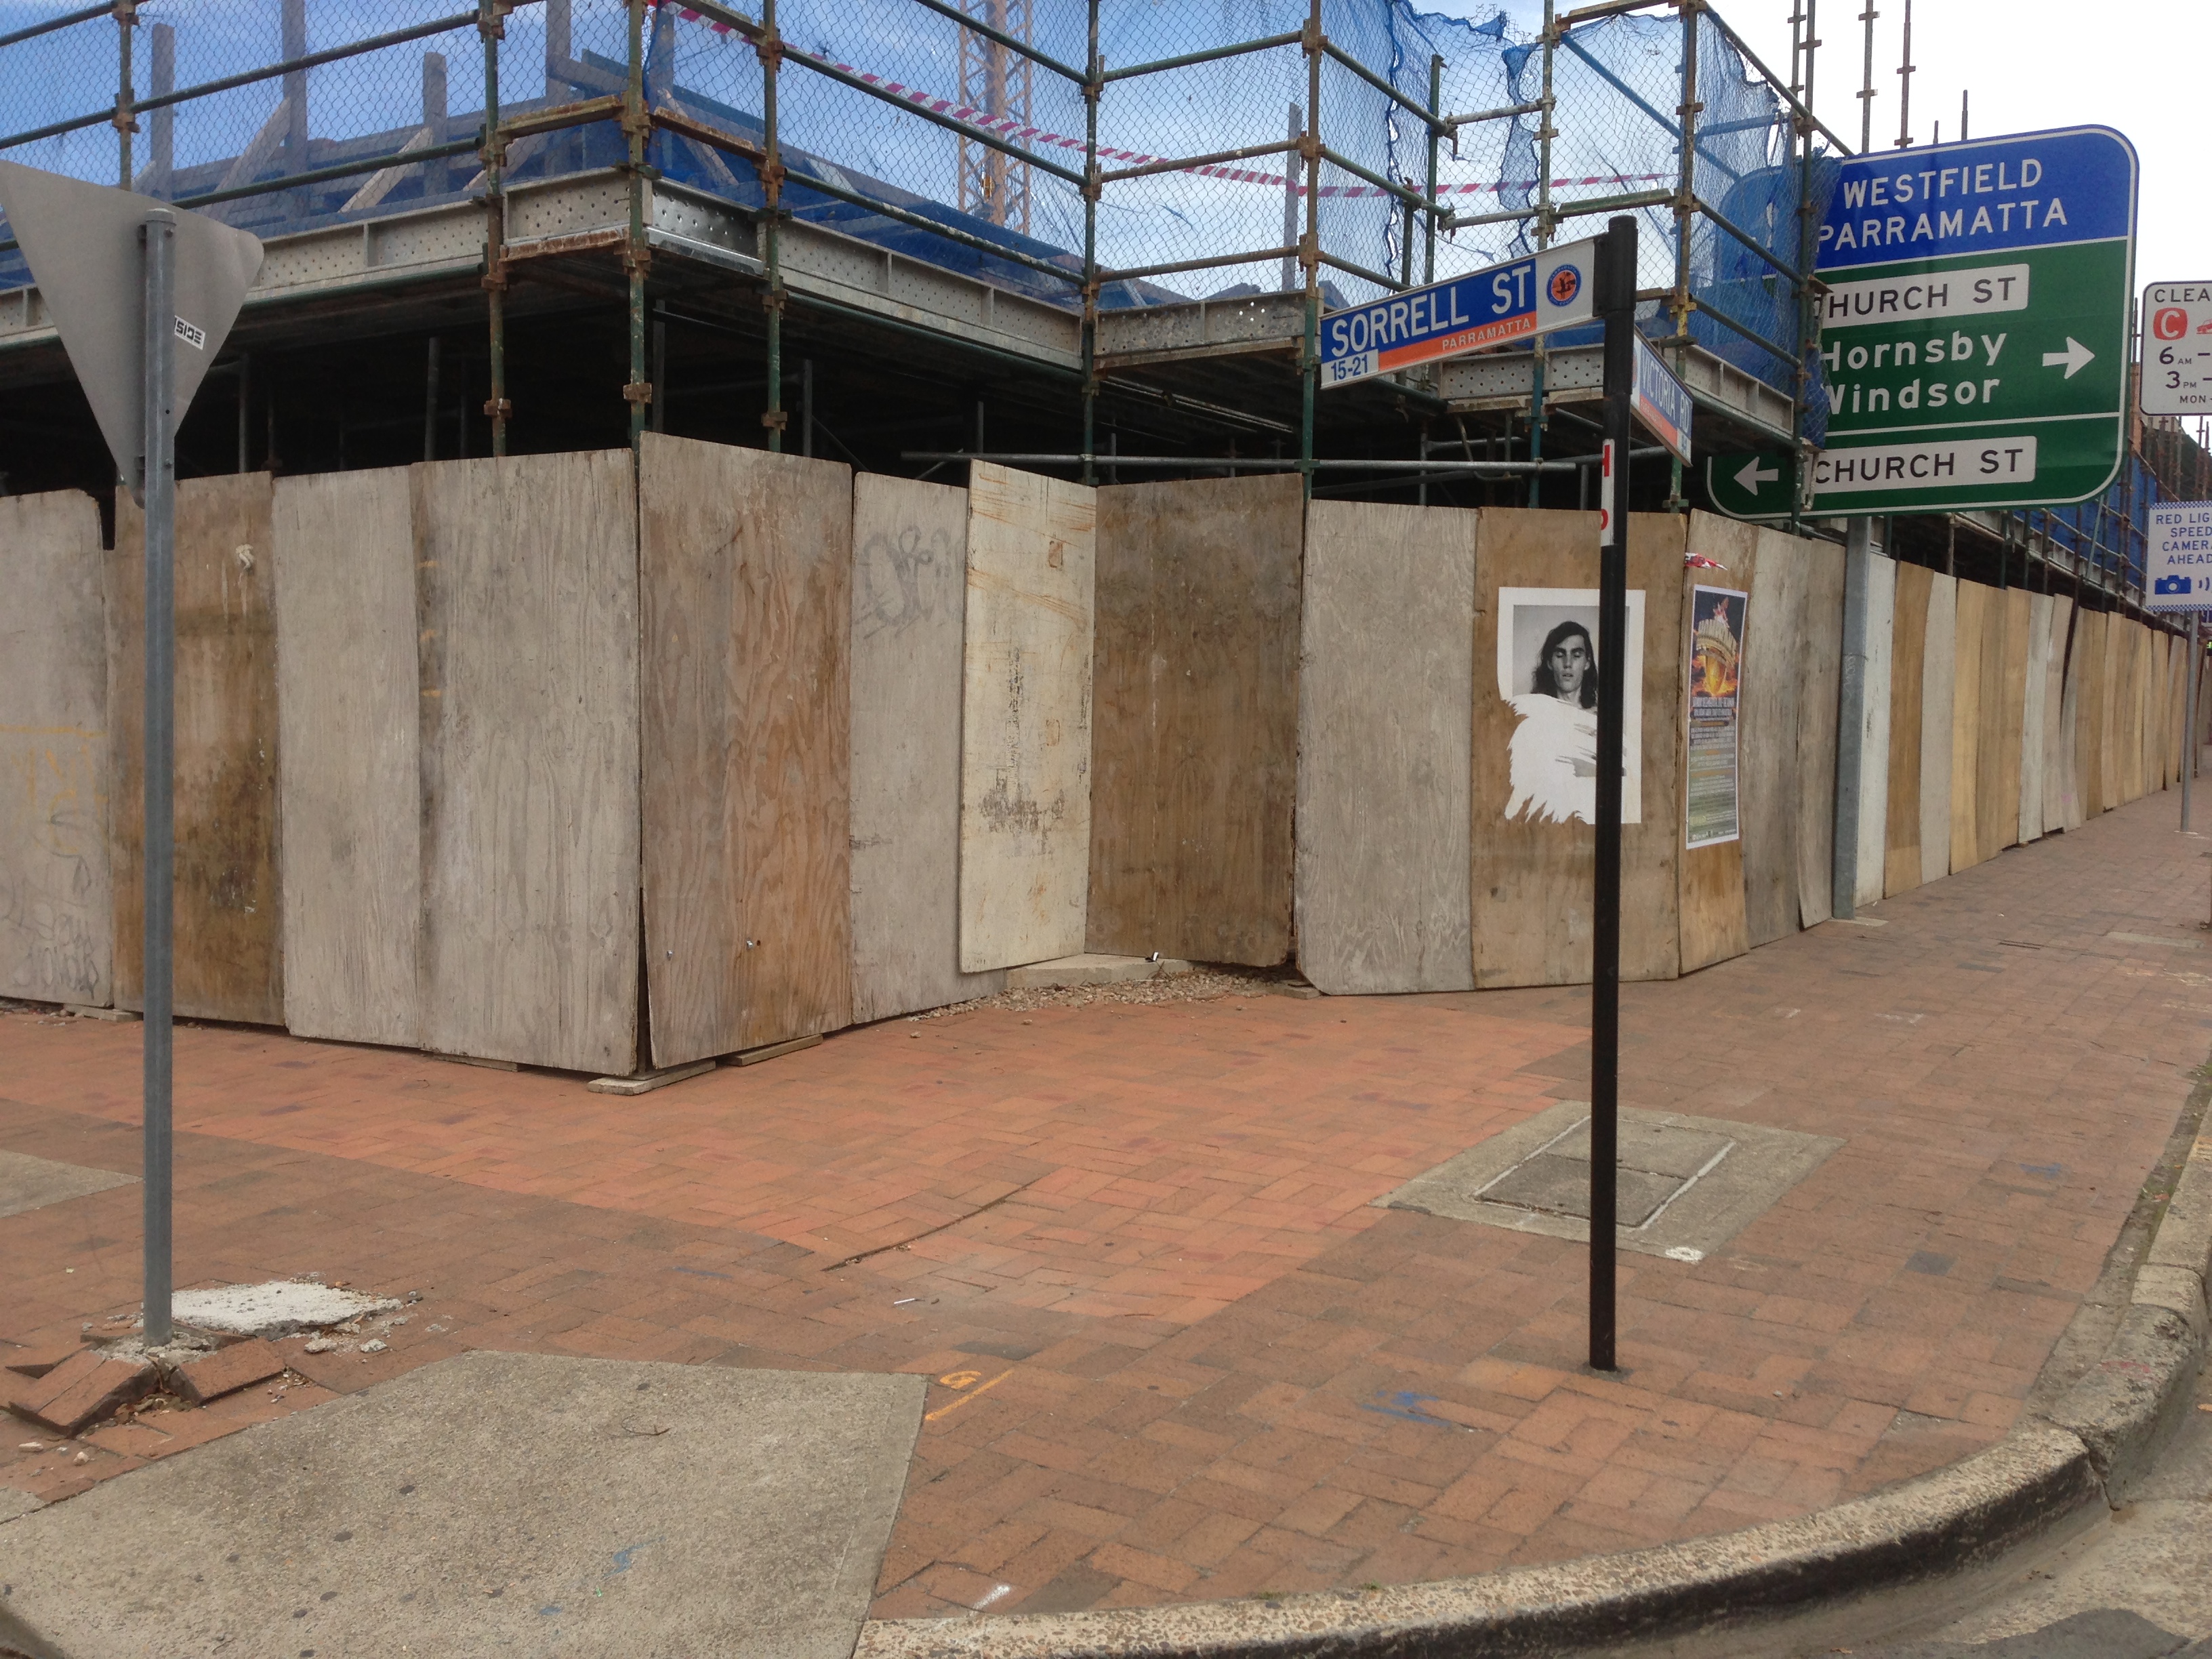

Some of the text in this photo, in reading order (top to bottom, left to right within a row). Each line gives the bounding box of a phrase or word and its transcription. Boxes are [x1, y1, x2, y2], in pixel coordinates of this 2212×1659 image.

[1843, 158, 2043, 209] WESTFIELD
[1816, 197, 2068, 253] PARRAMATTA
[1330, 286, 1469, 357] SORRELL
[1491, 265, 1531, 314] ST
[1814, 276, 2016, 319] HURCH ST
[1442, 317, 1531, 350] PARRAMATTA
[1820, 329, 2007, 371] Hornsby
[1330, 353, 1369, 382] 15-21
[1643, 349, 1676, 422] VICTORIA
[1679, 394, 1689, 434] RD
[1816, 448, 2024, 484] CHURCH ST
[2156, 512, 2212, 525] RED LIG
[2171, 526, 2212, 537] SPEED
[2162, 540, 2212, 552] CAMER
[2167, 553, 2212, 565] AHEAD
